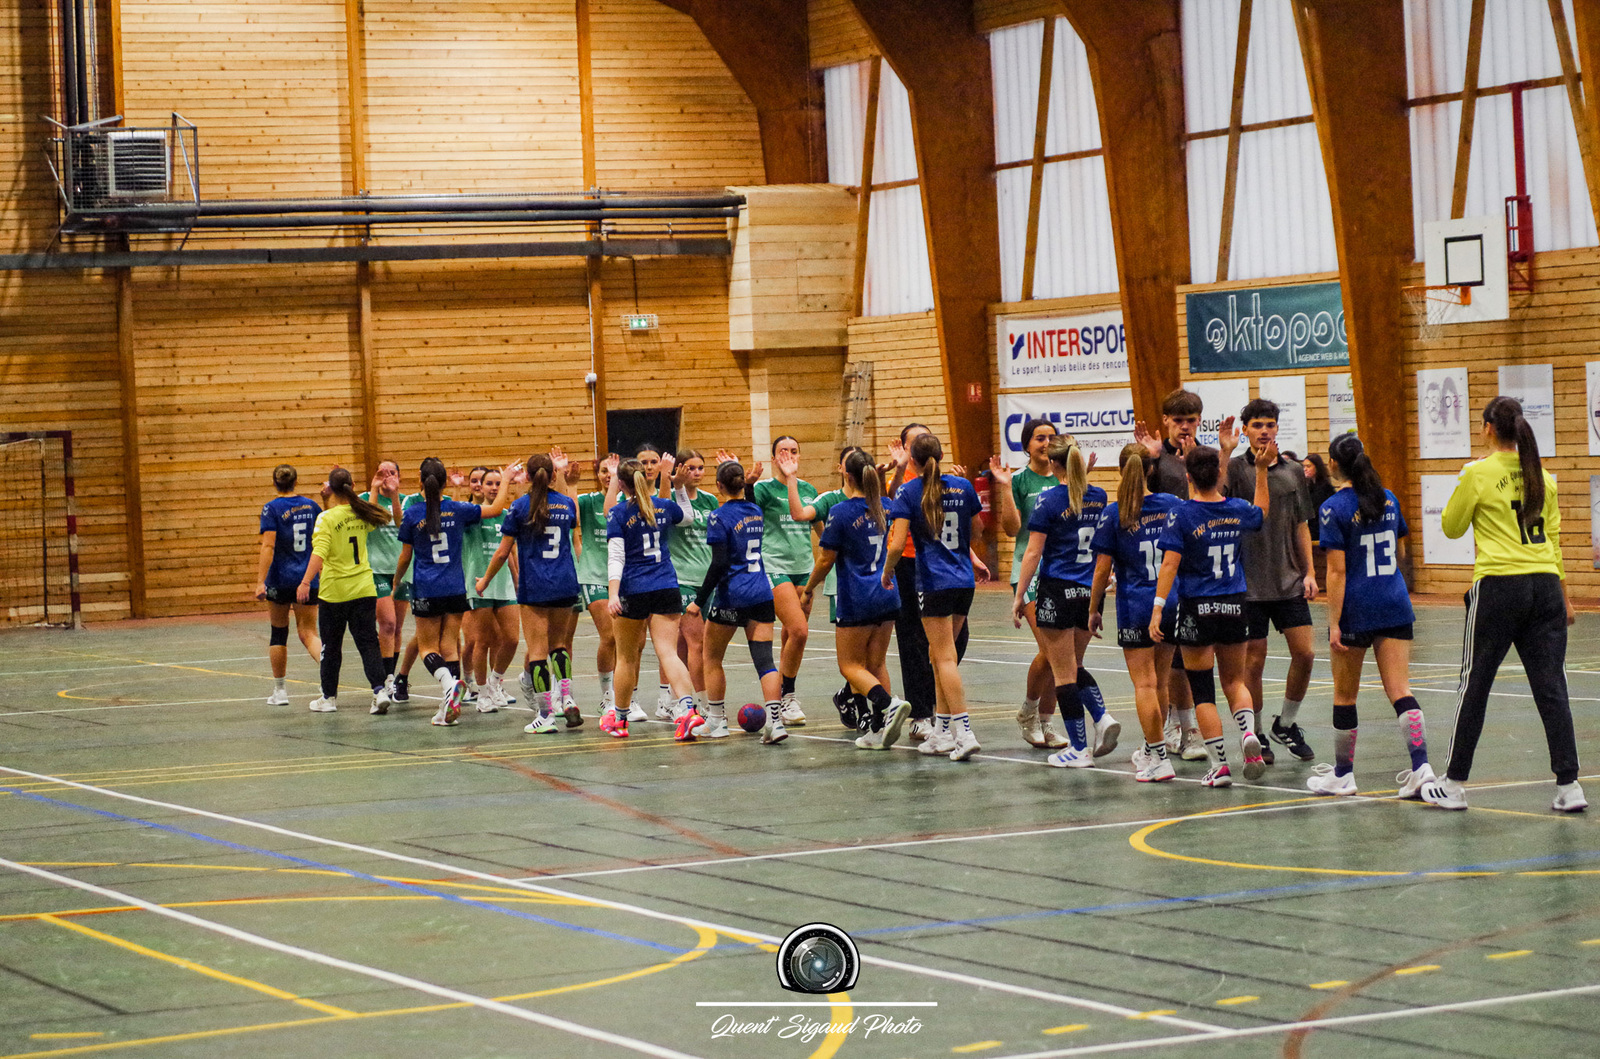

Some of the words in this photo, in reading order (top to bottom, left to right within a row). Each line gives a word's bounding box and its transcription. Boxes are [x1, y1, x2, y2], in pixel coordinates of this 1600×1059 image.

[1012, 366, 1020, 375] Le
[1044, 363, 1051, 373] la
[1053, 362, 1067, 374] plus
[1069, 361, 1086, 372] belle
[1088, 360, 1100, 370] des
[1298, 353, 1320, 362] AGENCE
[1321, 352, 1333, 361] WEB
[293, 518, 307, 552] 6
[542, 526, 561, 559] 3
[941, 511, 959, 549] 8
[1075, 527, 1096, 563] 9
[349, 536, 360, 565] 1
[430, 532, 450, 564] 2
[642, 531, 662, 563] 4
[746, 539, 761, 572] 5
[868, 535, 884, 572] 7
[1207, 543, 1236, 580] 11
[1360, 530, 1397, 577] 13
